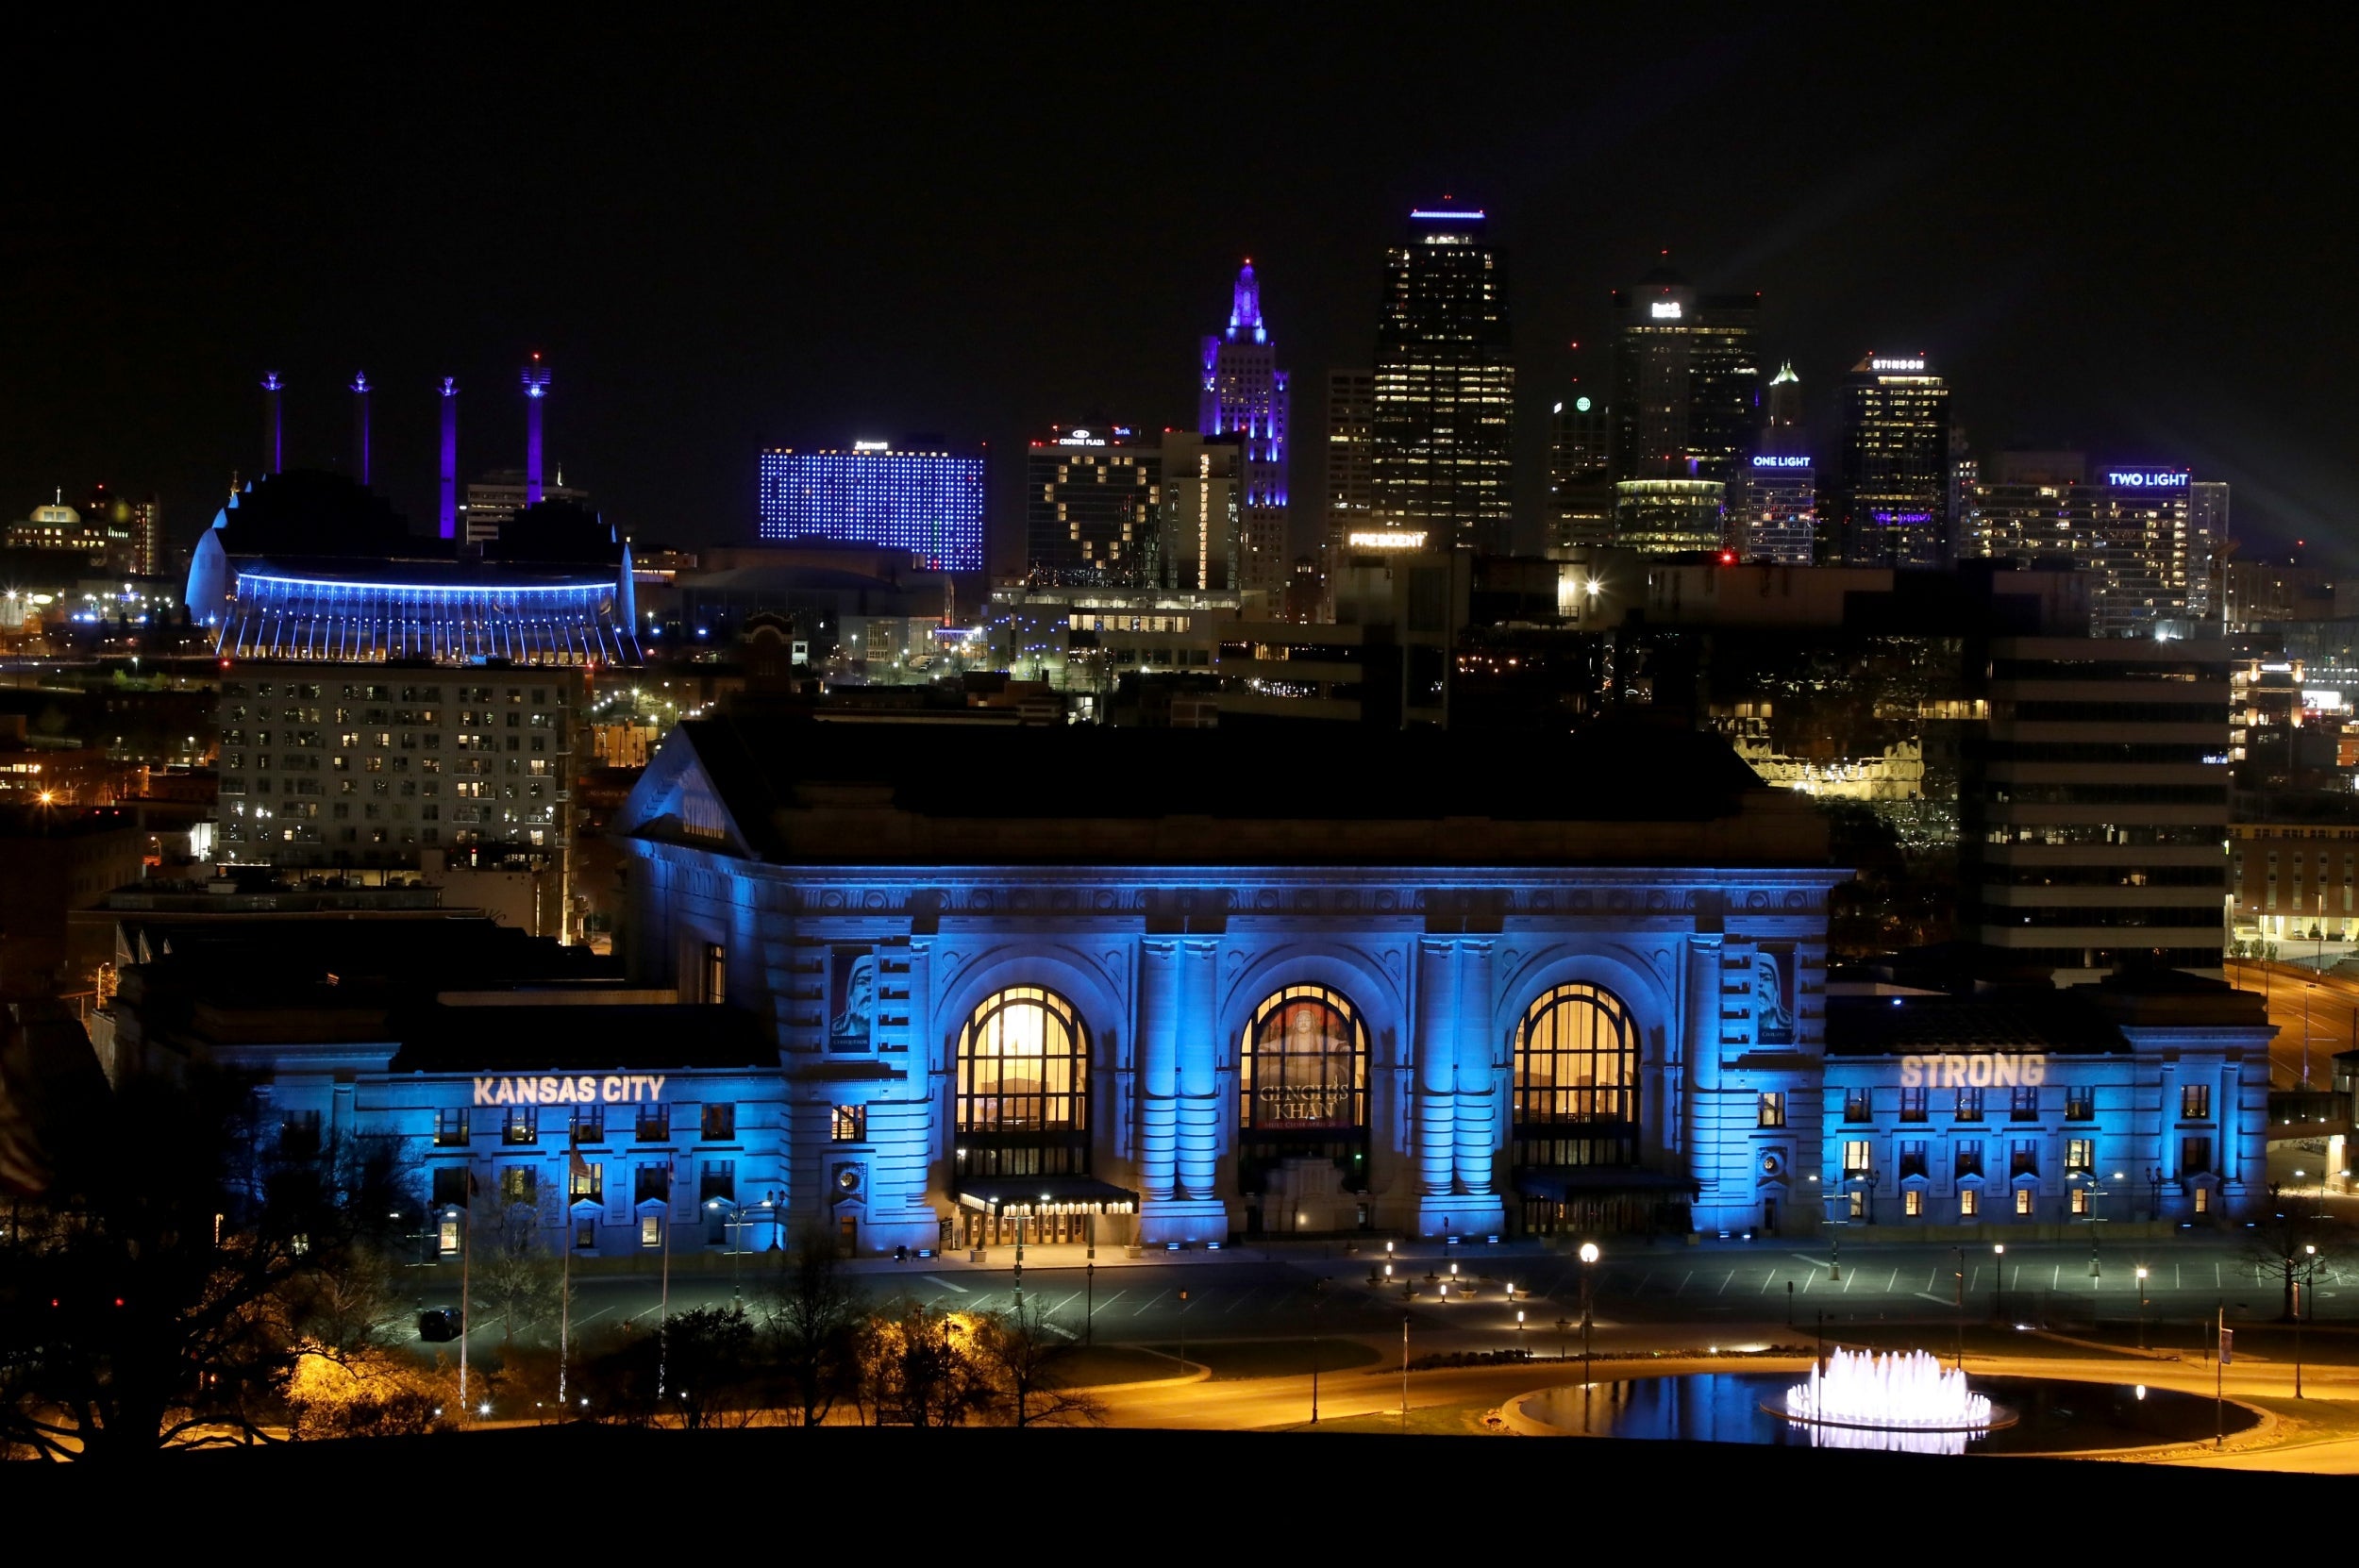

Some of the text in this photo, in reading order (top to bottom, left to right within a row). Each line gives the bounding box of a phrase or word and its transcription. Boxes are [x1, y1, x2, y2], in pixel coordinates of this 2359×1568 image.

[1872, 359, 1925, 370] STINSON
[1753, 457, 1811, 467] ONE LIGHT
[2109, 473, 2188, 486] TWO LIGHT
[1350, 533, 1425, 547] PRESIDENT
[683, 797, 726, 840] STRONG
[1900, 1053, 2046, 1088] STRONG
[474, 1076, 665, 1105] KANSAS CITY
[1260, 1081, 1349, 1103] GENGHIS
[1274, 1102, 1334, 1121] KHAN
